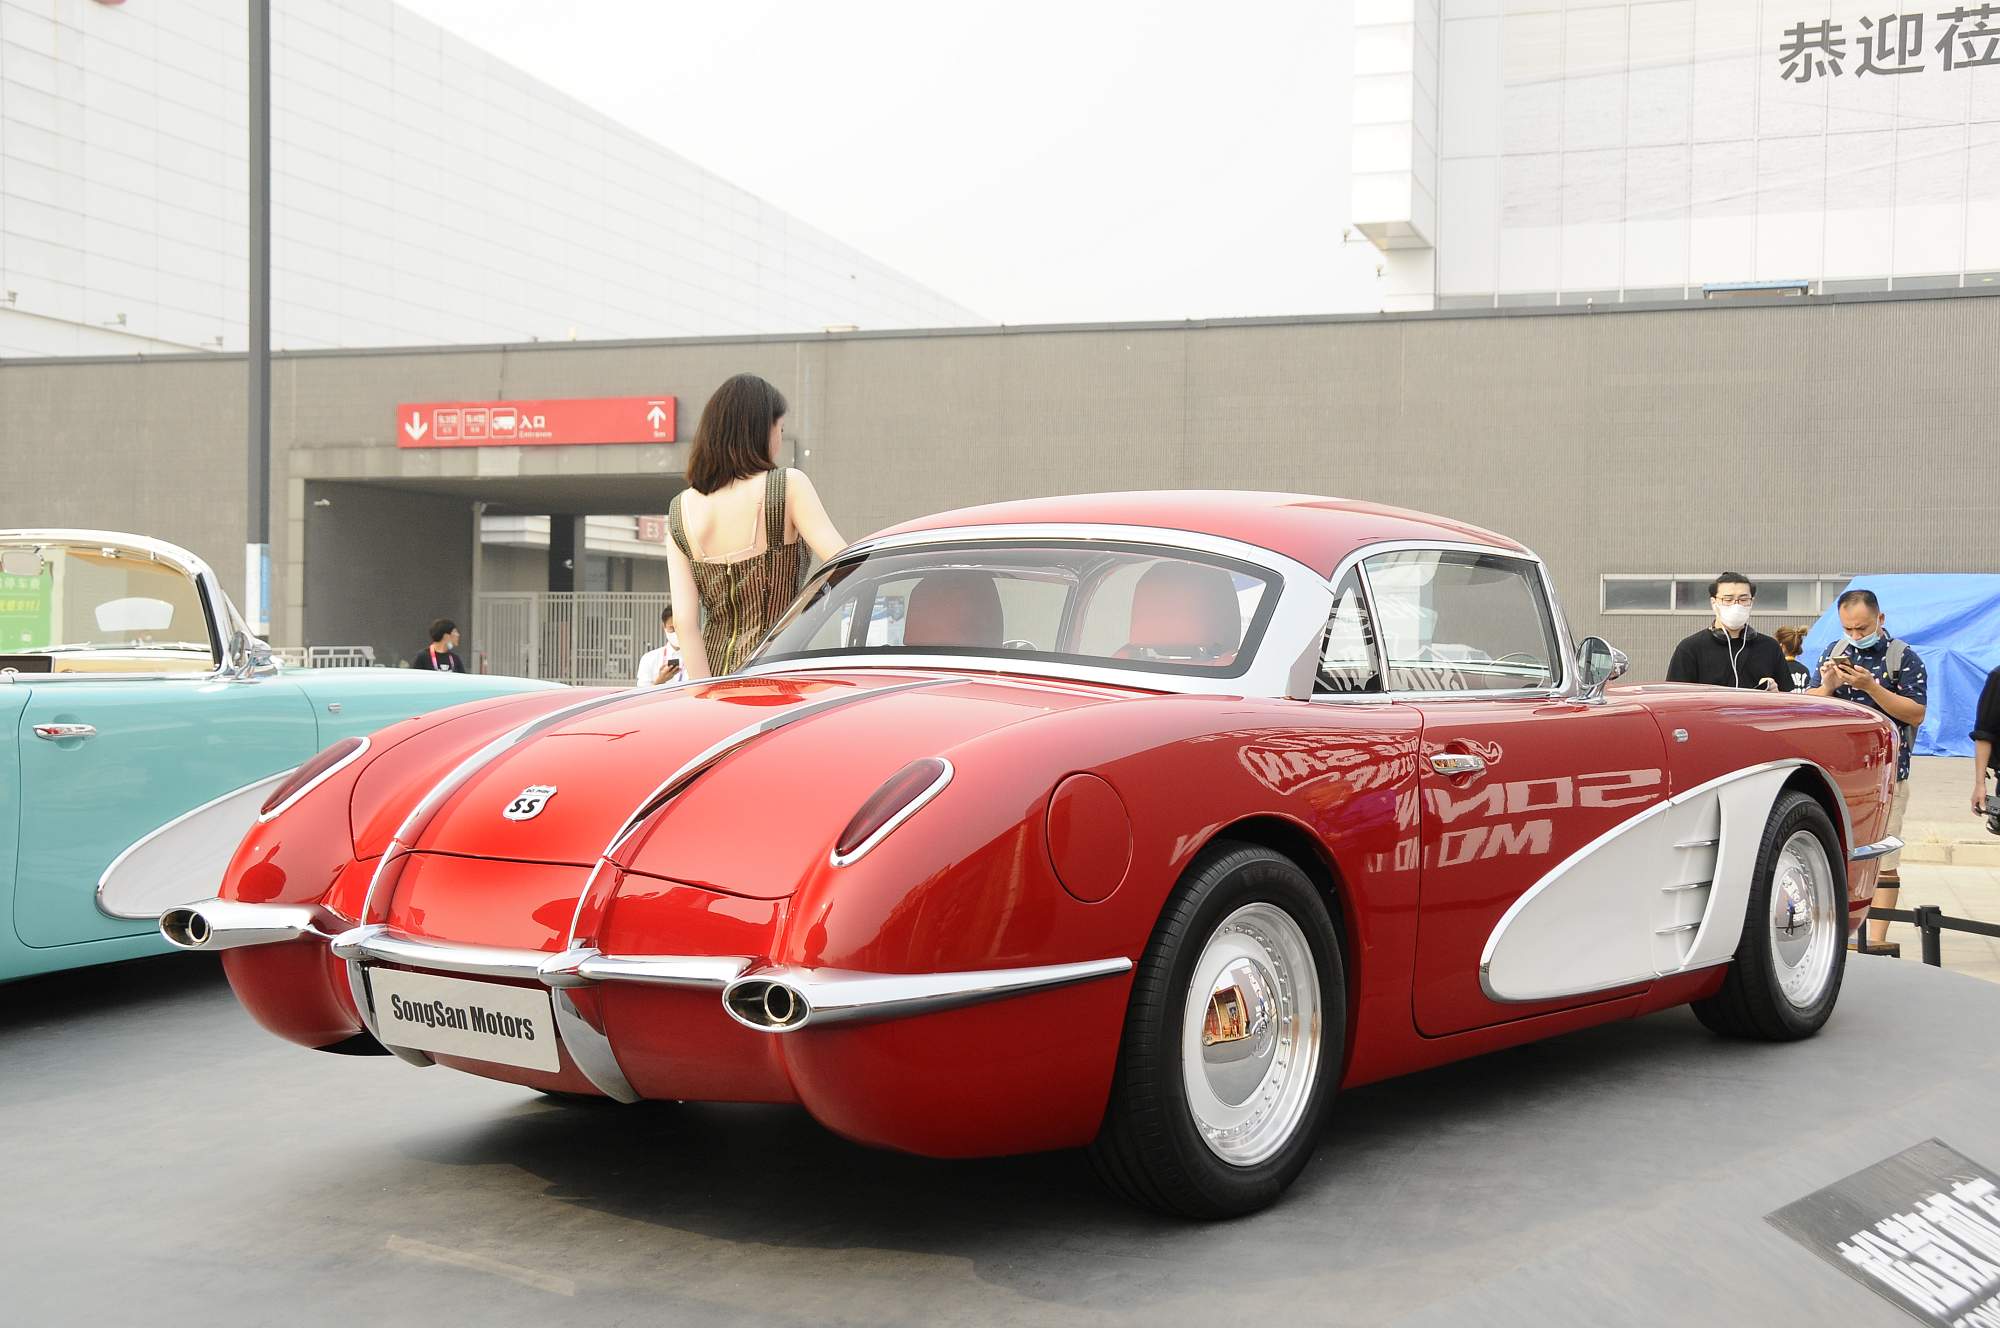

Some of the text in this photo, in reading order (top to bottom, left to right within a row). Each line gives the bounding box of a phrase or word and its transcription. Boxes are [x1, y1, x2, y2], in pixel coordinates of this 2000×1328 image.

[1778, 3, 2000, 83] 恭迎莅
[518, 414, 545, 429] 入口
[509, 798, 541, 813] SS
[390, 993, 535, 1041] SongSan Motors
